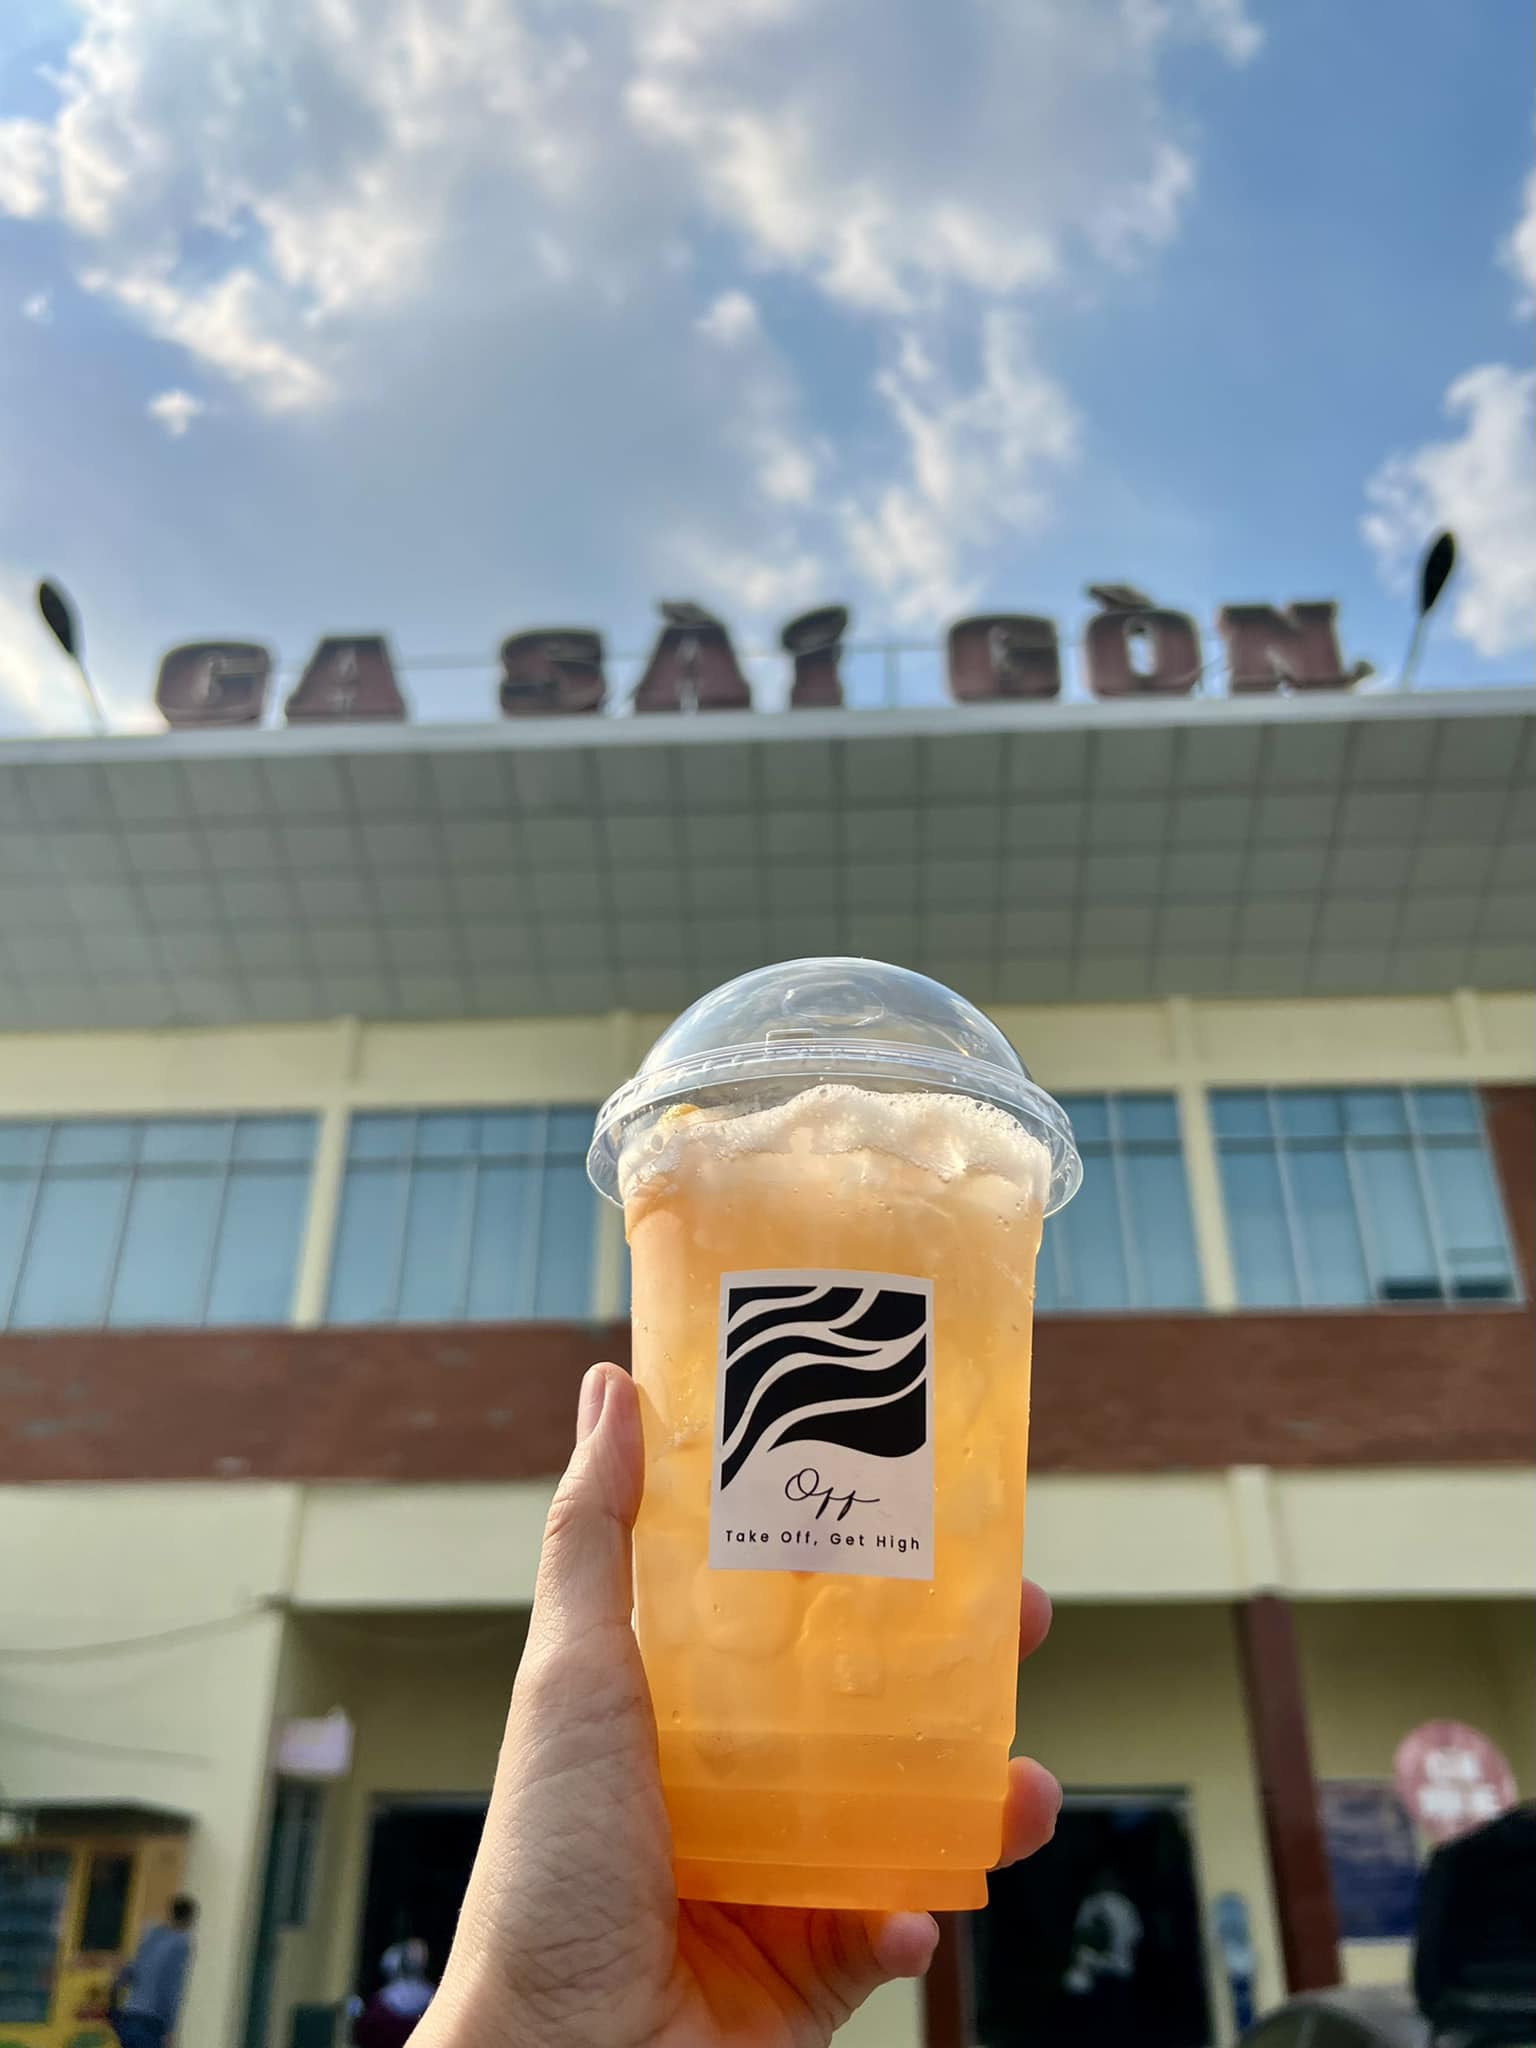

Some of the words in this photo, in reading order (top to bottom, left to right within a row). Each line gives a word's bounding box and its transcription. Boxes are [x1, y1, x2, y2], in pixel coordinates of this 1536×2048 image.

[155, 635, 411, 729] GA
[725, 1529, 770, 1544] Take
[780, 1530, 819, 1547] Off,
[829, 1532, 865, 1547] Get
[876, 1534, 921, 1553] High
